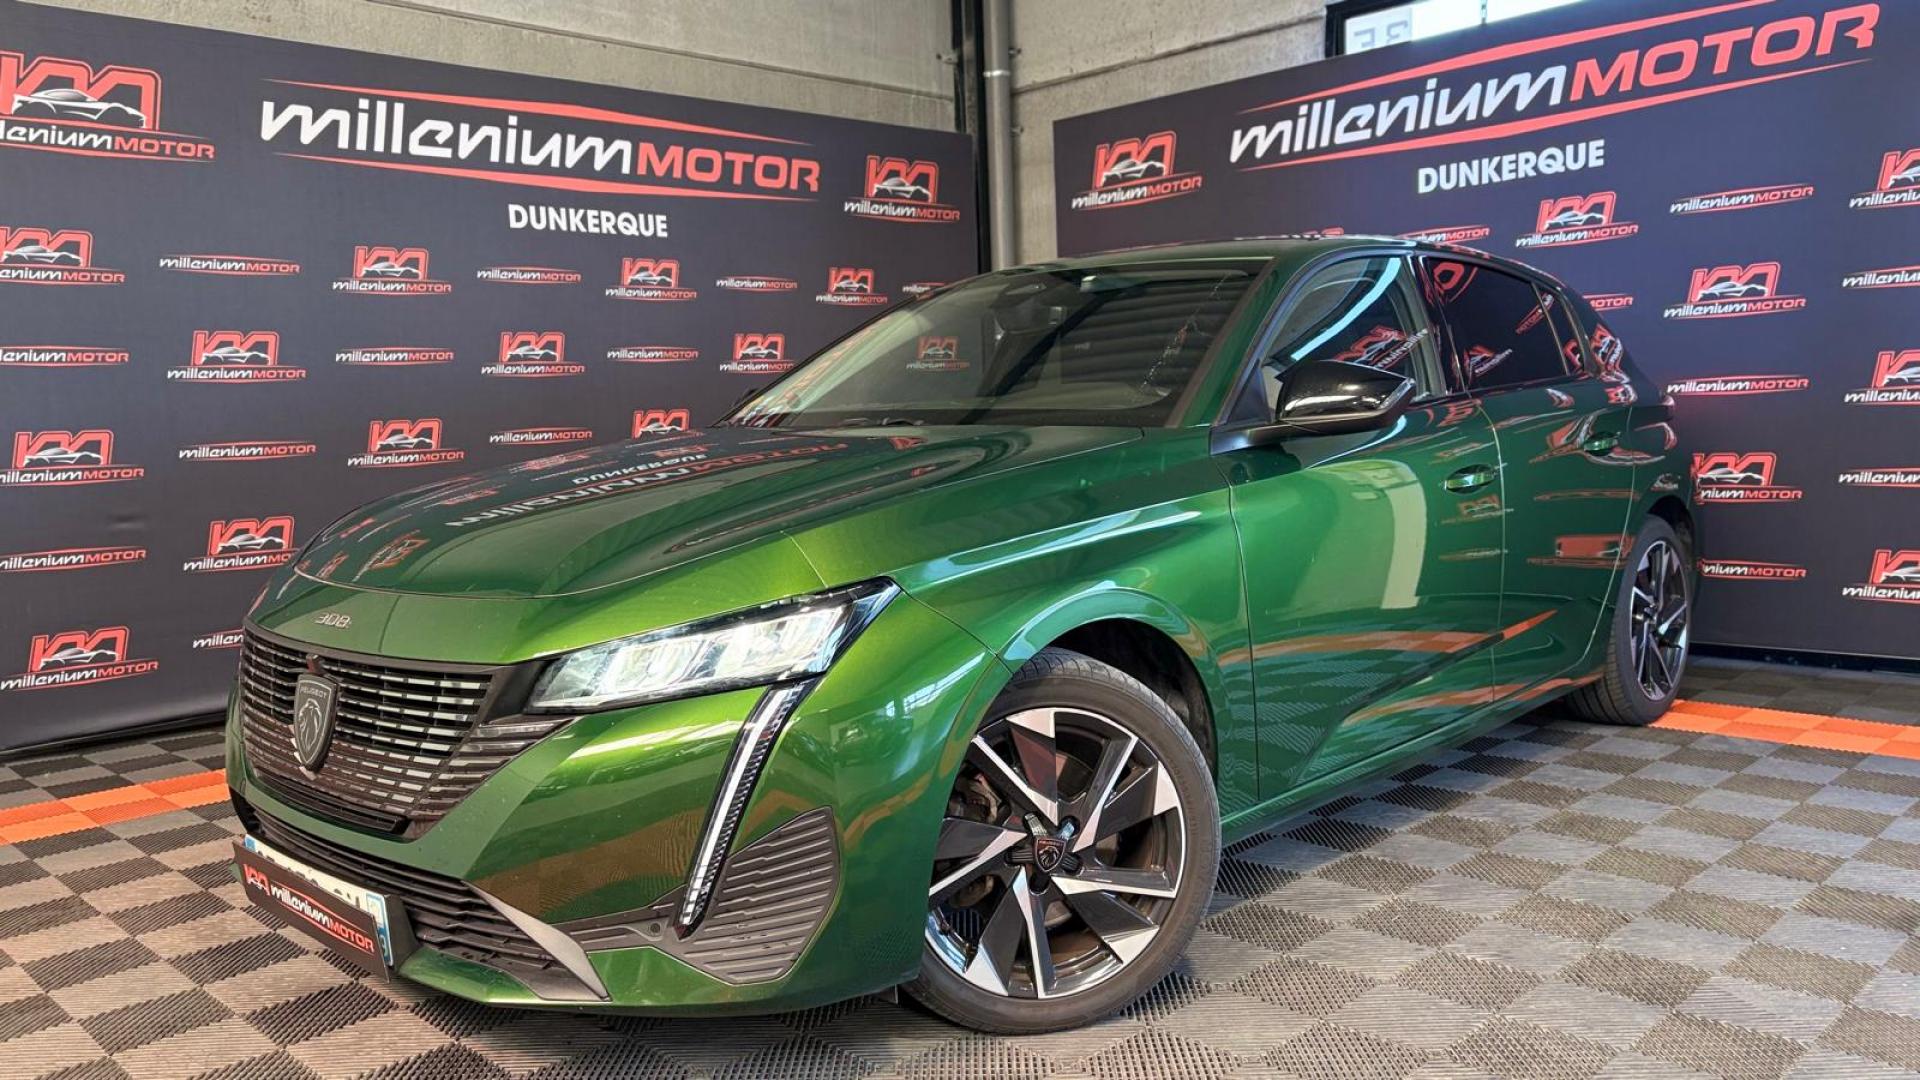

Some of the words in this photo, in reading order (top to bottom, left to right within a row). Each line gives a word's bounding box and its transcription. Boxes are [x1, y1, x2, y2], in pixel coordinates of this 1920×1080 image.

[1229, 3, 1880, 164] milleniumMOTOR
[260, 97, 820, 192] milleniumMOTOR
[1418, 138, 1605, 194] DUNKERQUE
[508, 203, 668, 238] DUNKERQUE
[1842, 270, 1920, 287] milleniu
[1844, 388, 1920, 403] milleniu
[315, 612, 350, 629] 308
